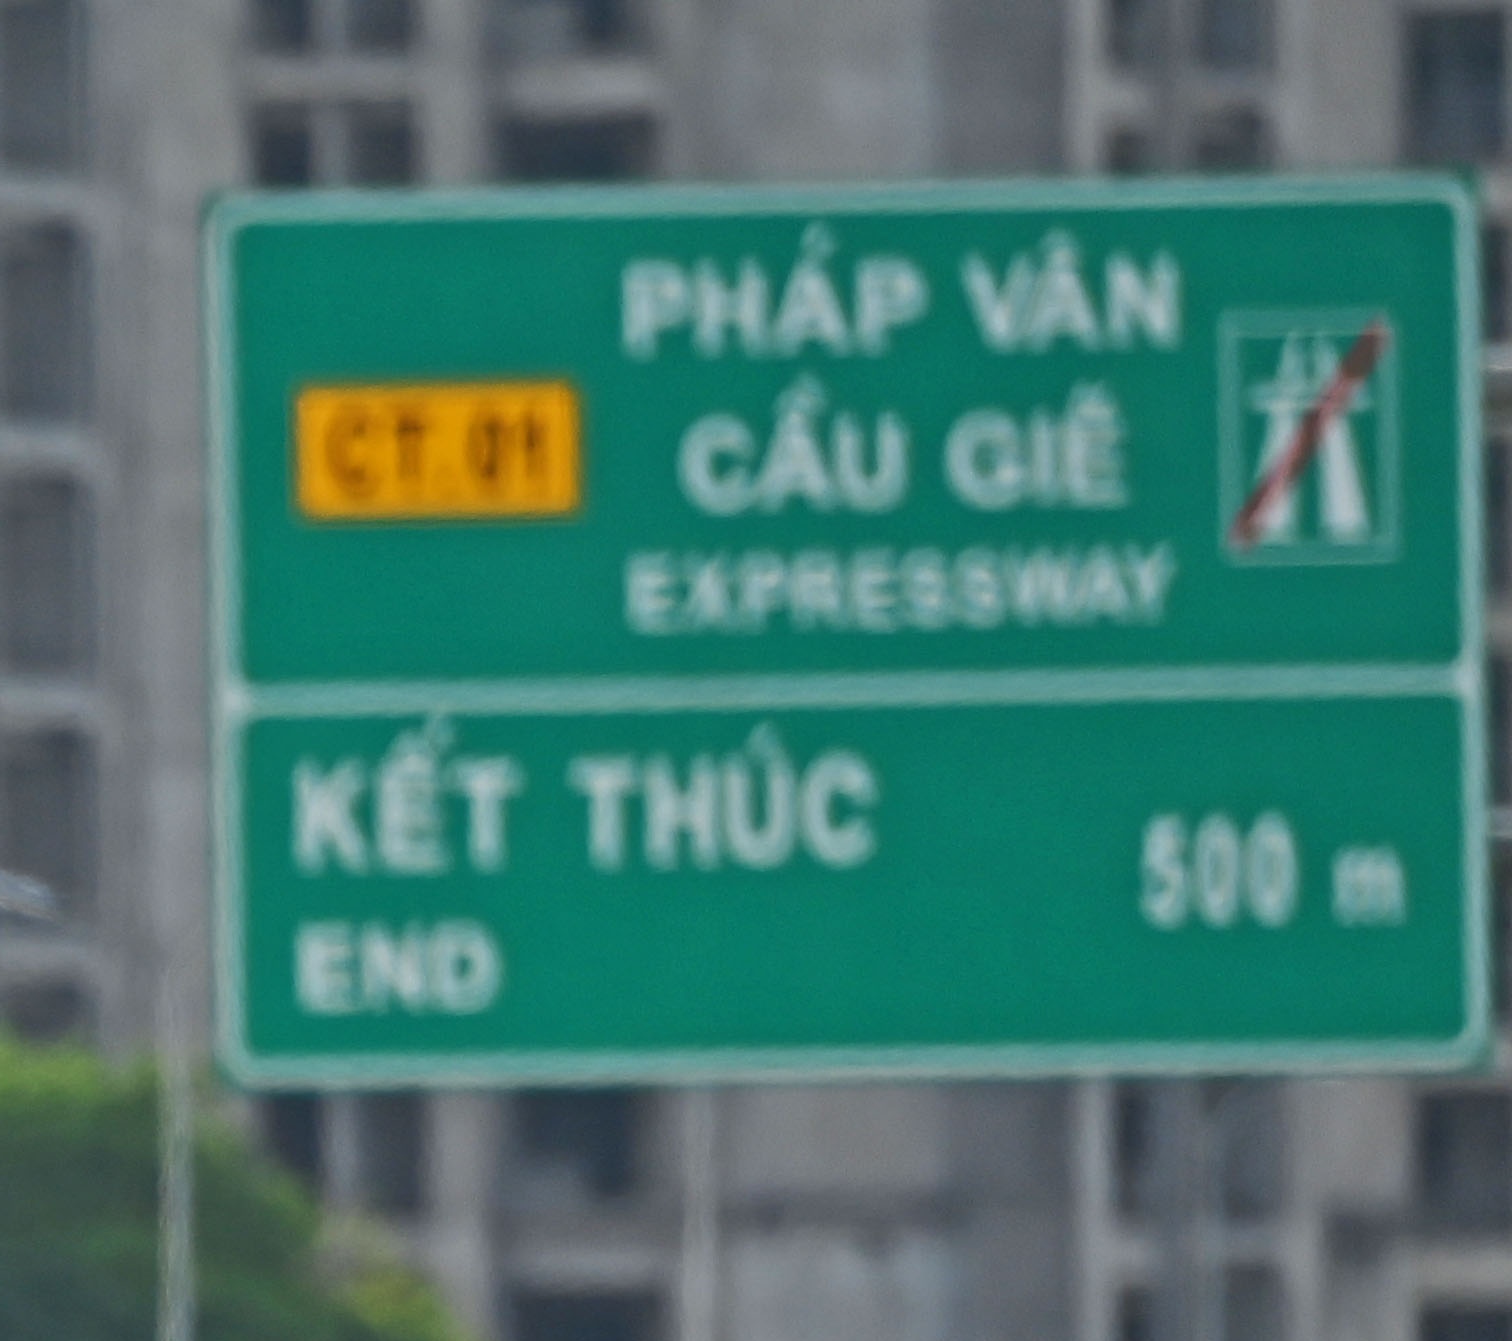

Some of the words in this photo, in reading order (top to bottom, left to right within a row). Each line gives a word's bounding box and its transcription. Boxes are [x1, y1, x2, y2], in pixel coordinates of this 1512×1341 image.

[622, 222, 930, 360] PHÁP
[963, 229, 1181, 356] VÂN
[623, 541, 1176, 638] EXPRESSWAY
[290, 712, 524, 877] KẾT
[569, 720, 879, 874] THÚC
[1140, 810, 1298, 930] 500
[1331, 846, 1406, 928] m
[293, 917, 504, 1018] END
